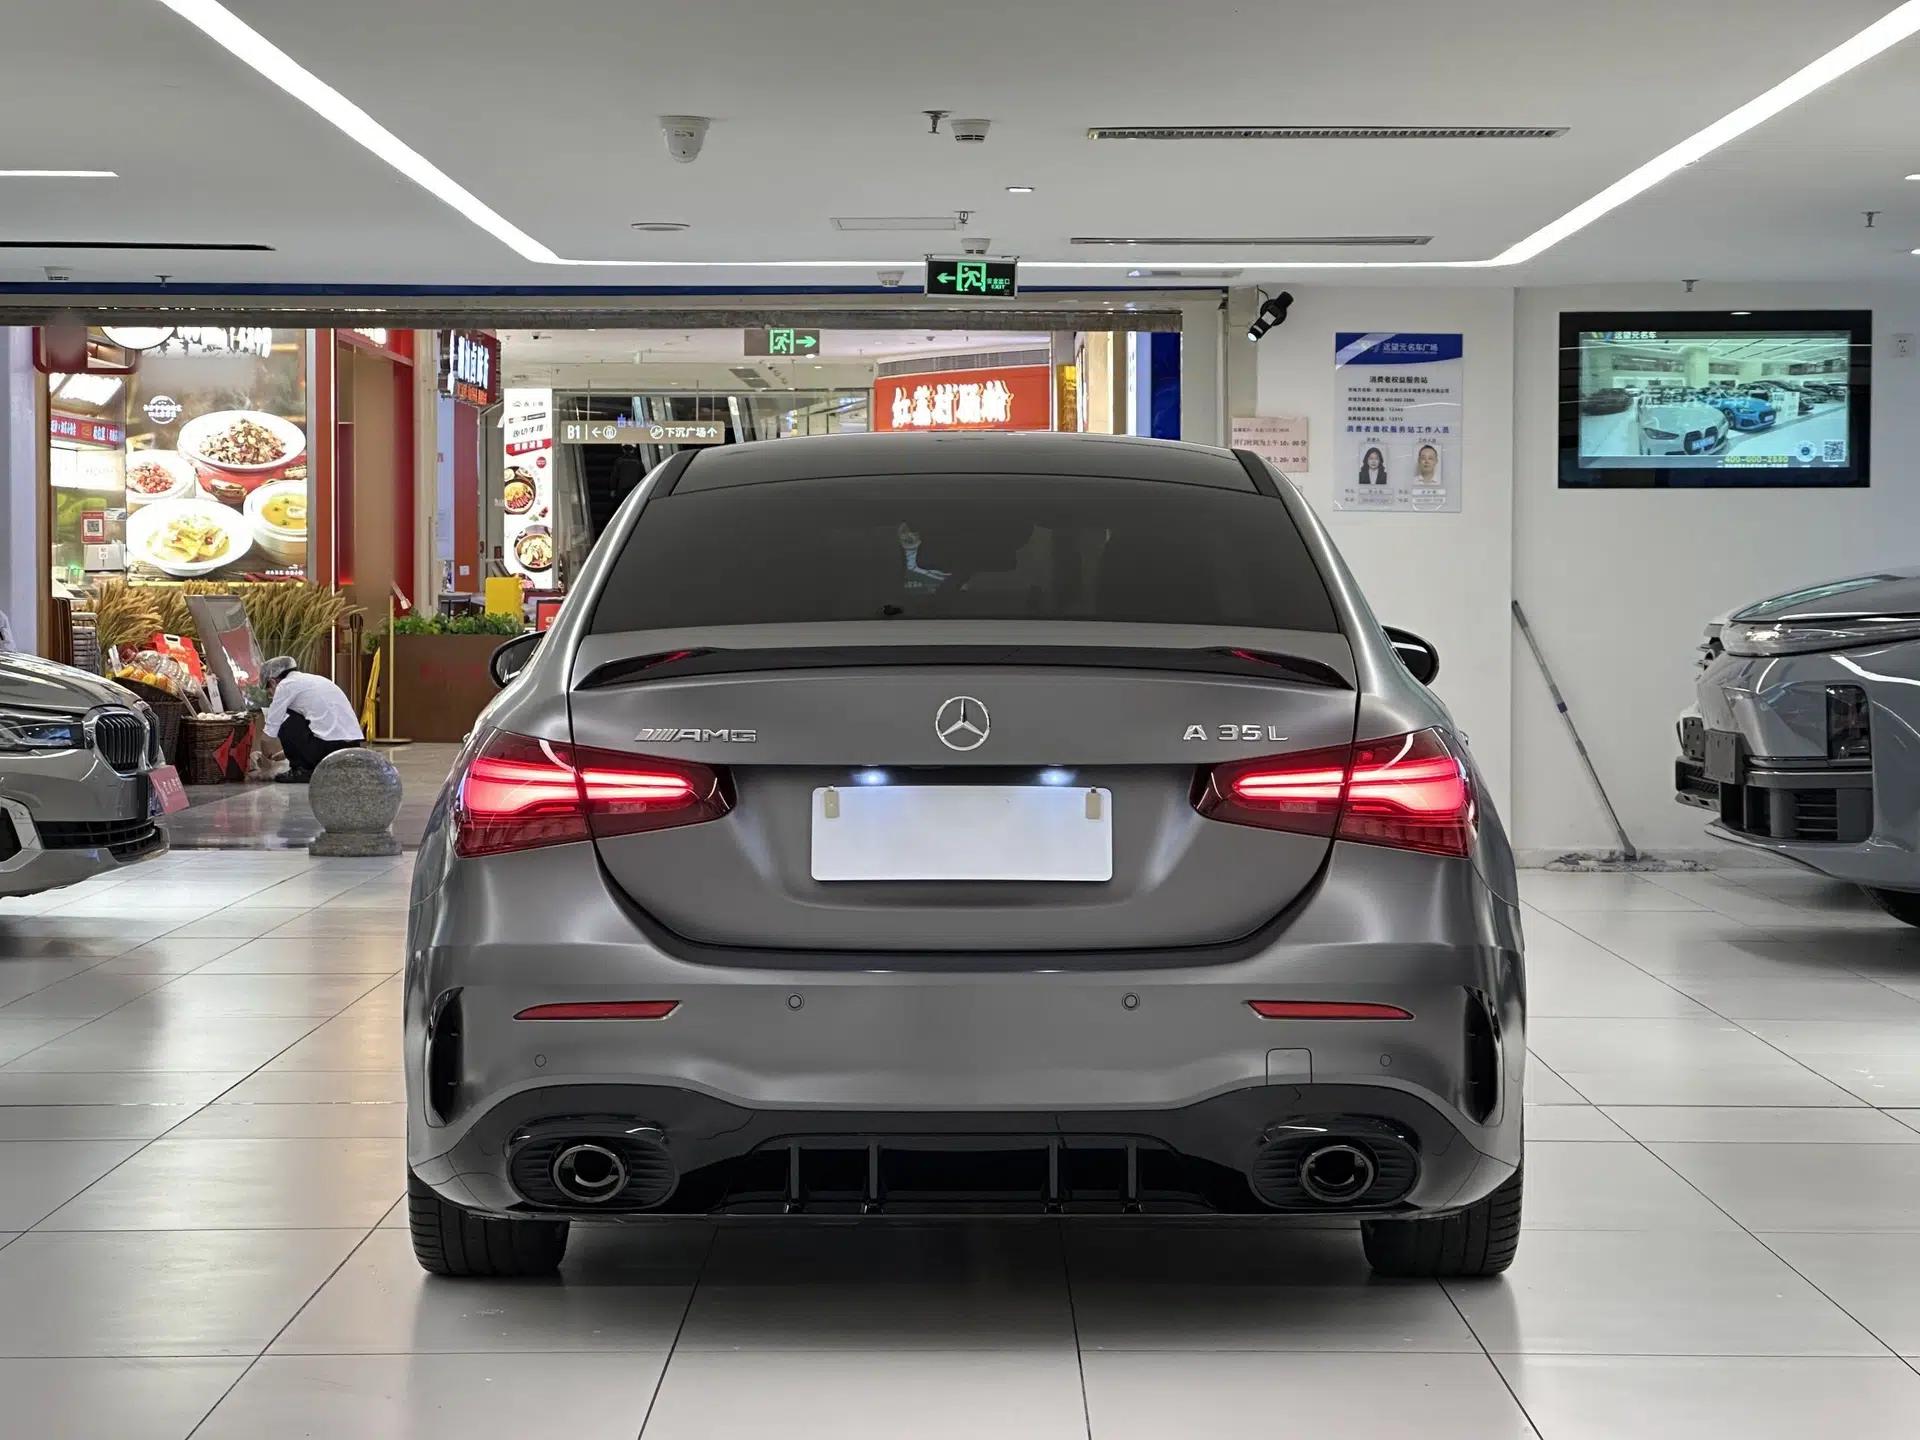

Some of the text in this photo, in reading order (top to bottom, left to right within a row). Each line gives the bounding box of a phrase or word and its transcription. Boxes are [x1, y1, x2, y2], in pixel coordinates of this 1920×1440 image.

[567, 425, 706, 439] B1 下沉广场
[674, 728, 757, 743] AMG
[1182, 724, 1208, 741] A
